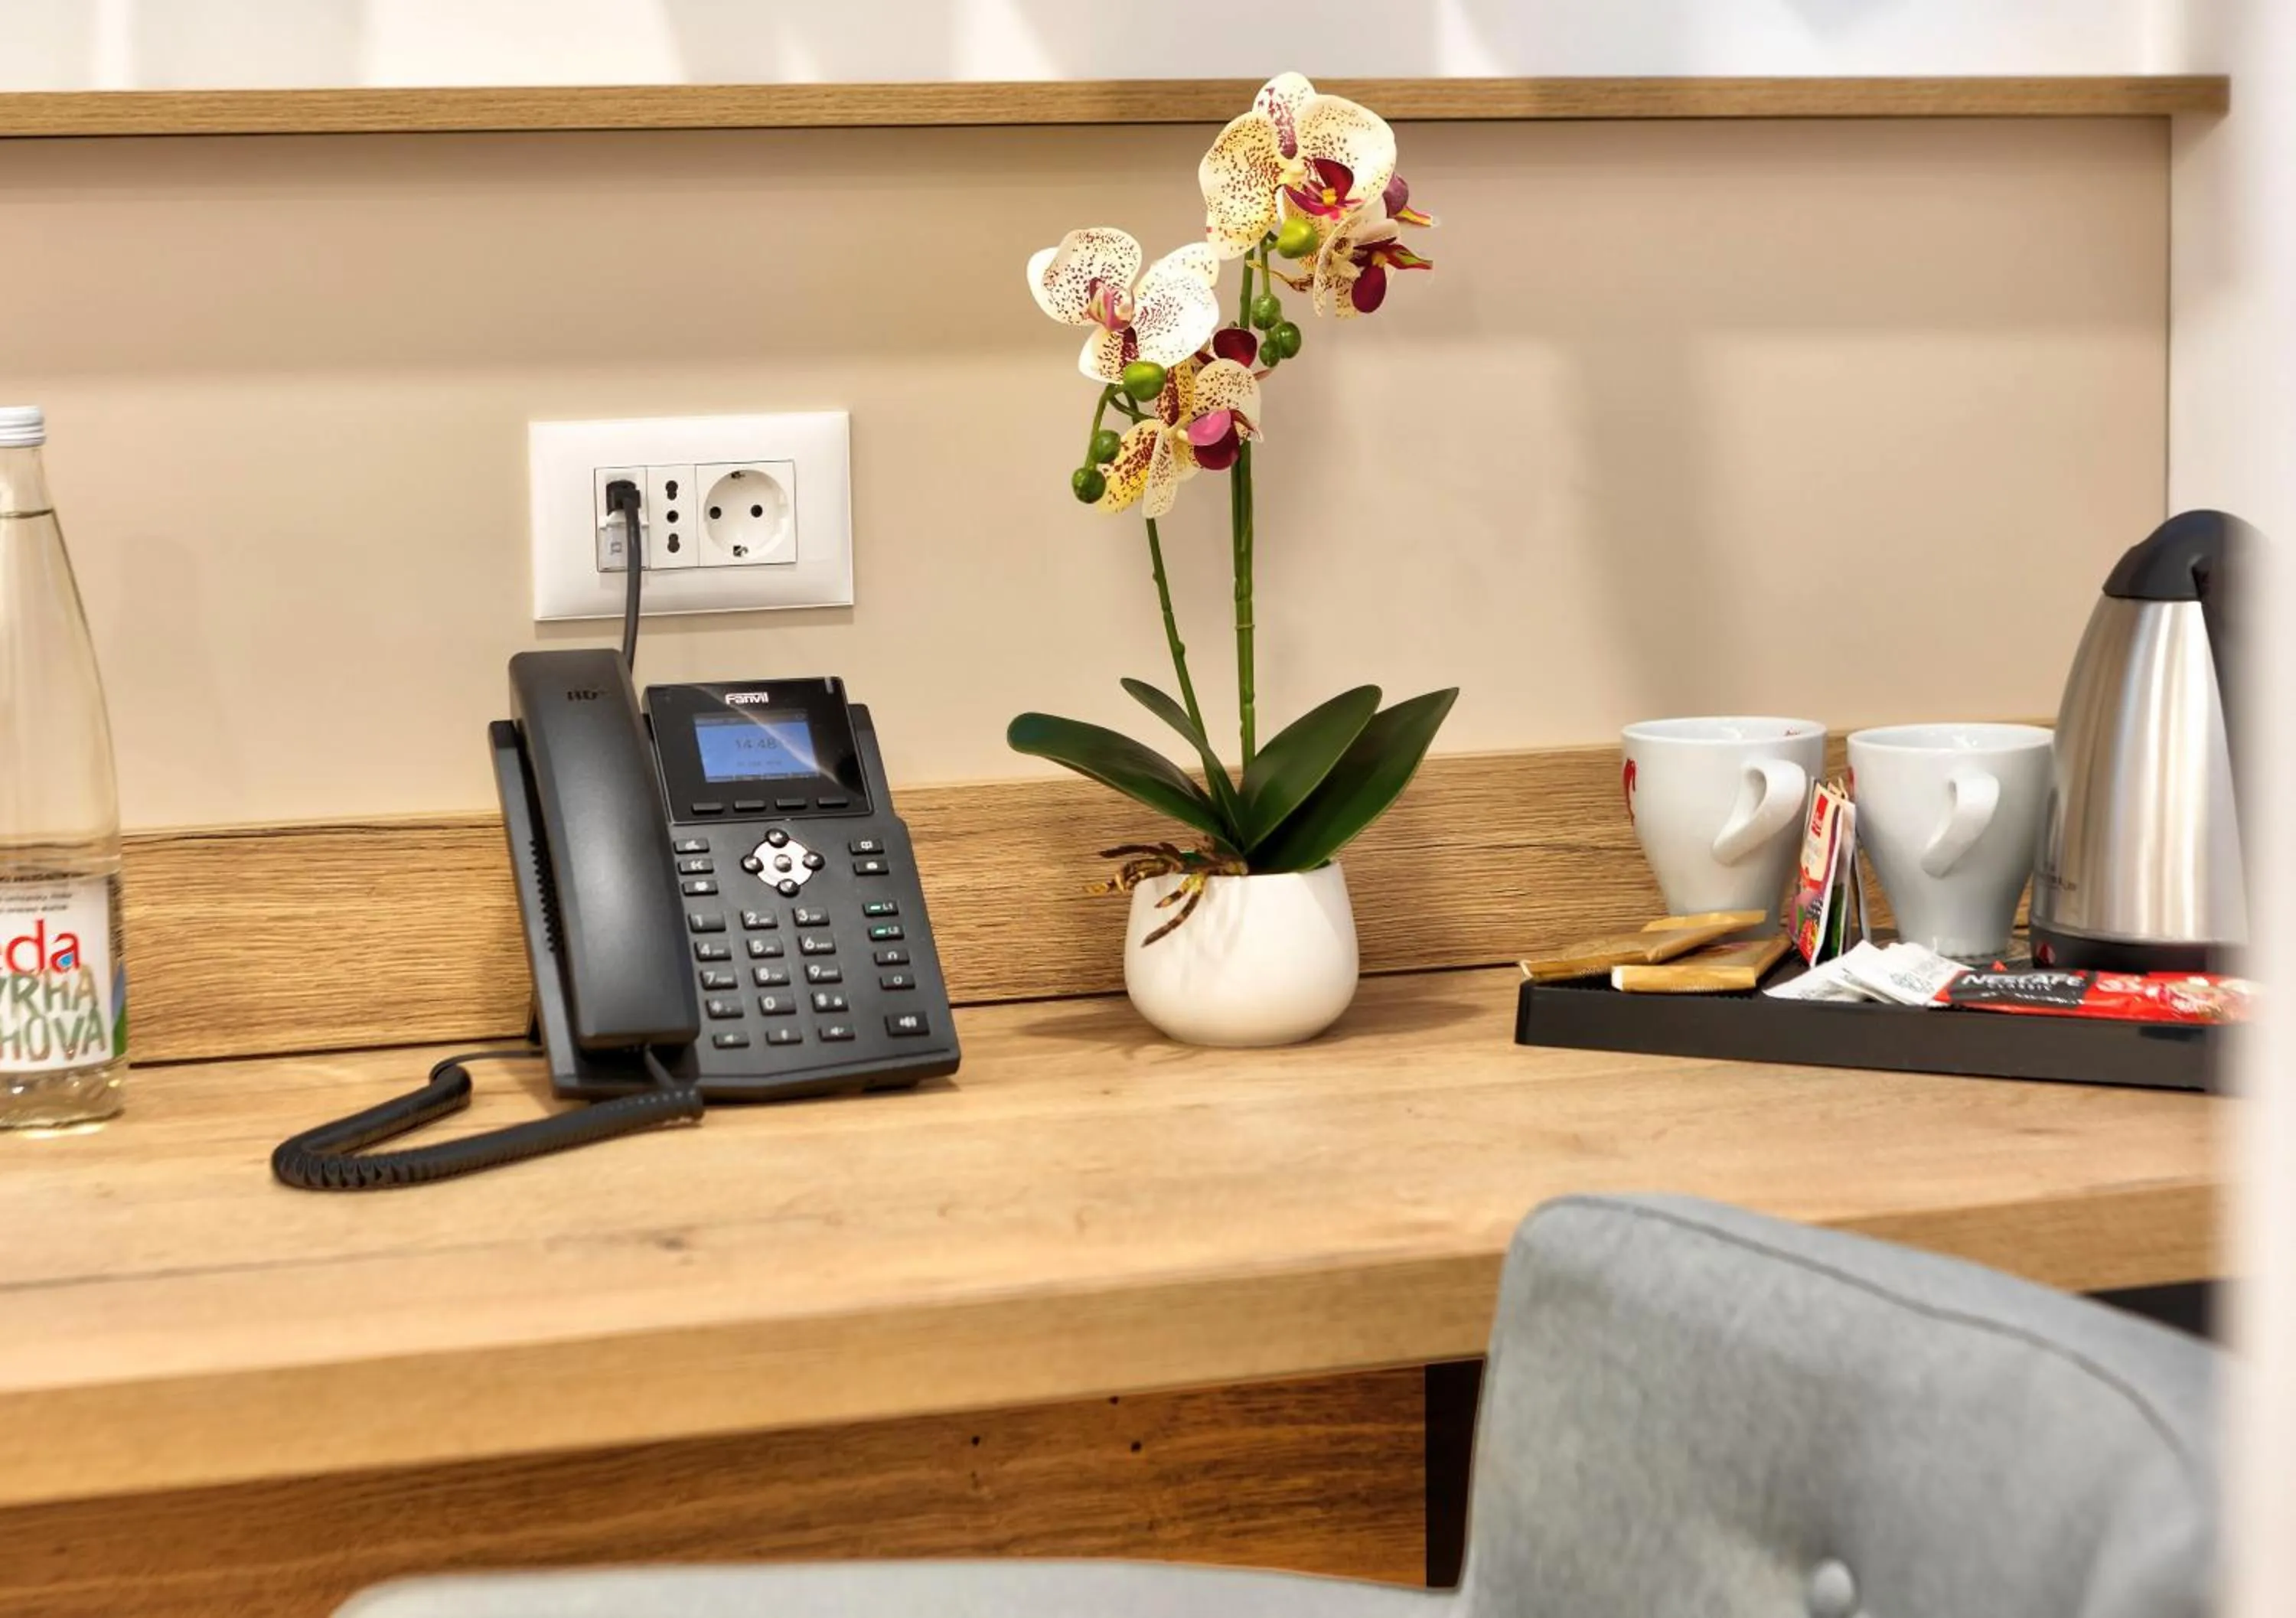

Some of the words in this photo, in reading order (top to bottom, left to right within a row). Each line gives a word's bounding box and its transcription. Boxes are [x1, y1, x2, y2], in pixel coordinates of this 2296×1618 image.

[725, 691, 769, 705] Fanvil
[746, 912, 757, 925] 2
[798, 908, 808, 922] 3
[0, 918, 80, 974] da
[700, 943, 711, 956] 4
[752, 940, 764, 953] 5
[804, 936, 815, 950] 6
[705, 970, 716, 985] 7
[759, 967, 770, 980] 8
[809, 964, 820, 979] 9
[764, 997, 776, 1010] 0
